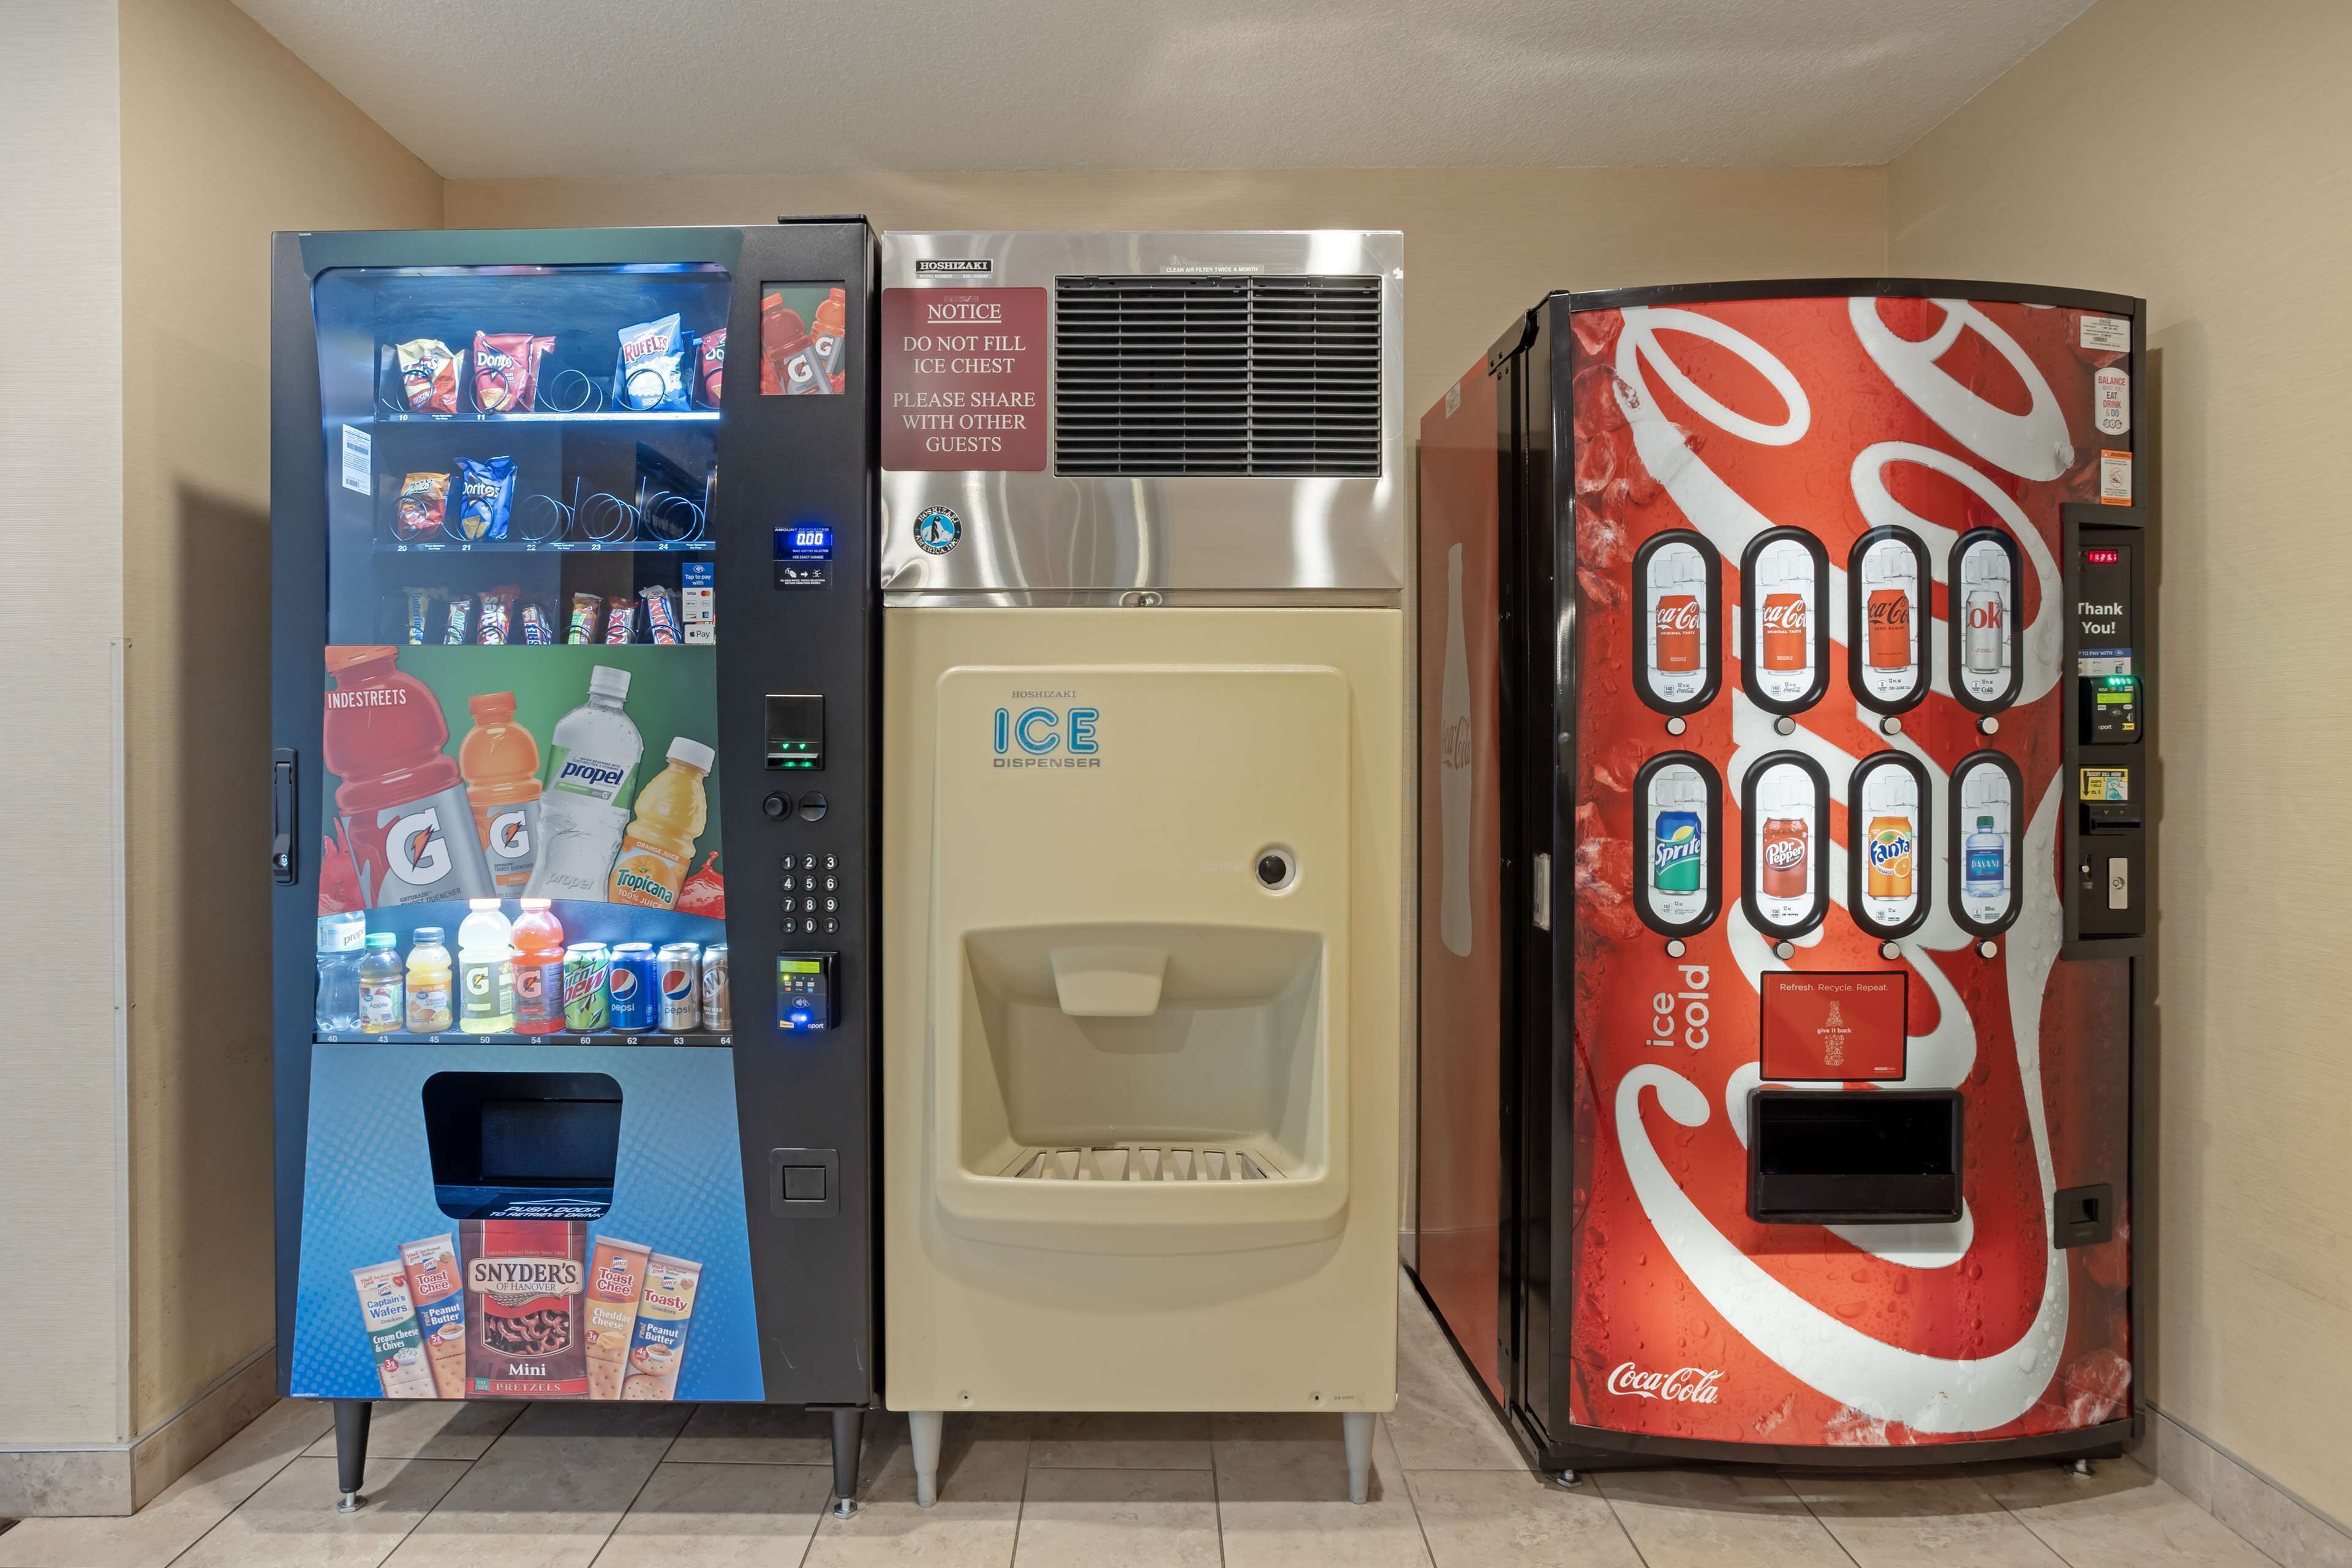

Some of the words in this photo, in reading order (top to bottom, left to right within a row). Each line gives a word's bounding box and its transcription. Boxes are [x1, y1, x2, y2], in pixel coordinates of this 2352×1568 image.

[927, 304, 1002, 319] NOTICE
[622, 335, 670, 363] RUFFLES
[903, 336, 932, 352] DO
[937, 336, 979, 351] NOT
[983, 336, 1027, 351] FILL
[913, 358, 946, 374] ICE
[951, 358, 1015, 374] CHEST
[2098, 376, 2126, 386] BALANCE
[892, 392, 965, 407] PLEASE
[971, 392, 1036, 407] SHARE
[2103, 400, 2122, 409] DRINK
[902, 415, 954, 429] WITH
[959, 414, 1027, 429] OTHER
[925, 437, 1002, 452] GUESTS
[797, 533, 823, 545] 0.00
[2078, 602, 2123, 616] Thank
[696, 630, 710, 639] Pay
[2082, 622, 2116, 634] You!
[328, 688, 407, 709] INDESTREETS
[994, 706, 1099, 755] ICE
[993, 758, 1100, 767] DISPENSER
[560, 762, 624, 785] propel
[489, 810, 530, 858] G
[385, 807, 453, 886] G
[636, 842, 662, 855] ORANGE
[663, 850, 680, 862] JUICE
[1656, 834, 1700, 867] Sprite
[1778, 840, 1795, 854] Dr
[1870, 837, 1910, 866] Fanta
[785, 857, 790, 867] 1
[806, 857, 813, 867] 2
[827, 857, 834, 867] 3
[1769, 844, 1803, 865] Pepper
[510, 863, 533, 872] QUENCHER
[546, 872, 594, 891] propel
[617, 869, 674, 904] Tropicana
[784, 878, 791, 888] 4
[806, 878, 813, 888] 5
[827, 878, 834, 889] 6
[400, 890, 429, 903] GATORADE
[426, 888, 461, 903] QUENCHER
[619, 889, 639, 902] 100%
[640, 897, 663, 908] JUICE
[785, 900, 791, 910] 7
[807, 900, 813, 910] 8
[827, 899, 834, 910] 9
[807, 921, 813, 931] 0
[466, 967, 489, 995] G
[516, 970, 541, 998] G
[612, 1003, 635, 1012] pepsi
[665, 1006, 690, 1015] pepsi
[1678, 965, 1709, 1050] cold
[1646, 992, 1675, 1047] ice
[416, 1270, 448, 1285] Toast
[475, 1262, 579, 1285] SNYDER'S
[599, 1268, 633, 1286] Toast
[419, 1281, 449, 1295] Chee
[496, 1282, 509, 1291] OF
[511, 1283, 557, 1291] HANOVER
[597, 1279, 631, 1296] Chee
[367, 1294, 406, 1309] Captain's
[644, 1289, 688, 1312] Toasty
[369, 1303, 408, 1319] Wafers
[429, 1303, 461, 1315] Peanut
[594, 1308, 632, 1323] Cheddar
[651, 1305, 676, 1315] Crackers
[431, 1313, 459, 1325] Butter
[592, 1316, 623, 1330] Cheese
[372, 1333, 395, 1344] Cream
[396, 1328, 420, 1340] Cheese
[587, 1332, 597, 1340] 3g
[647, 1323, 679, 1338] Peanut
[382, 1341, 405, 1351] Chives
[645, 1332, 674, 1345] Butter
[636, 1348, 647, 1357] 4g
[509, 1363, 546, 1376] Mini
[495, 1383, 561, 1392] PRETZELS
[1607, 1362, 1725, 1404] Coca-Cola
